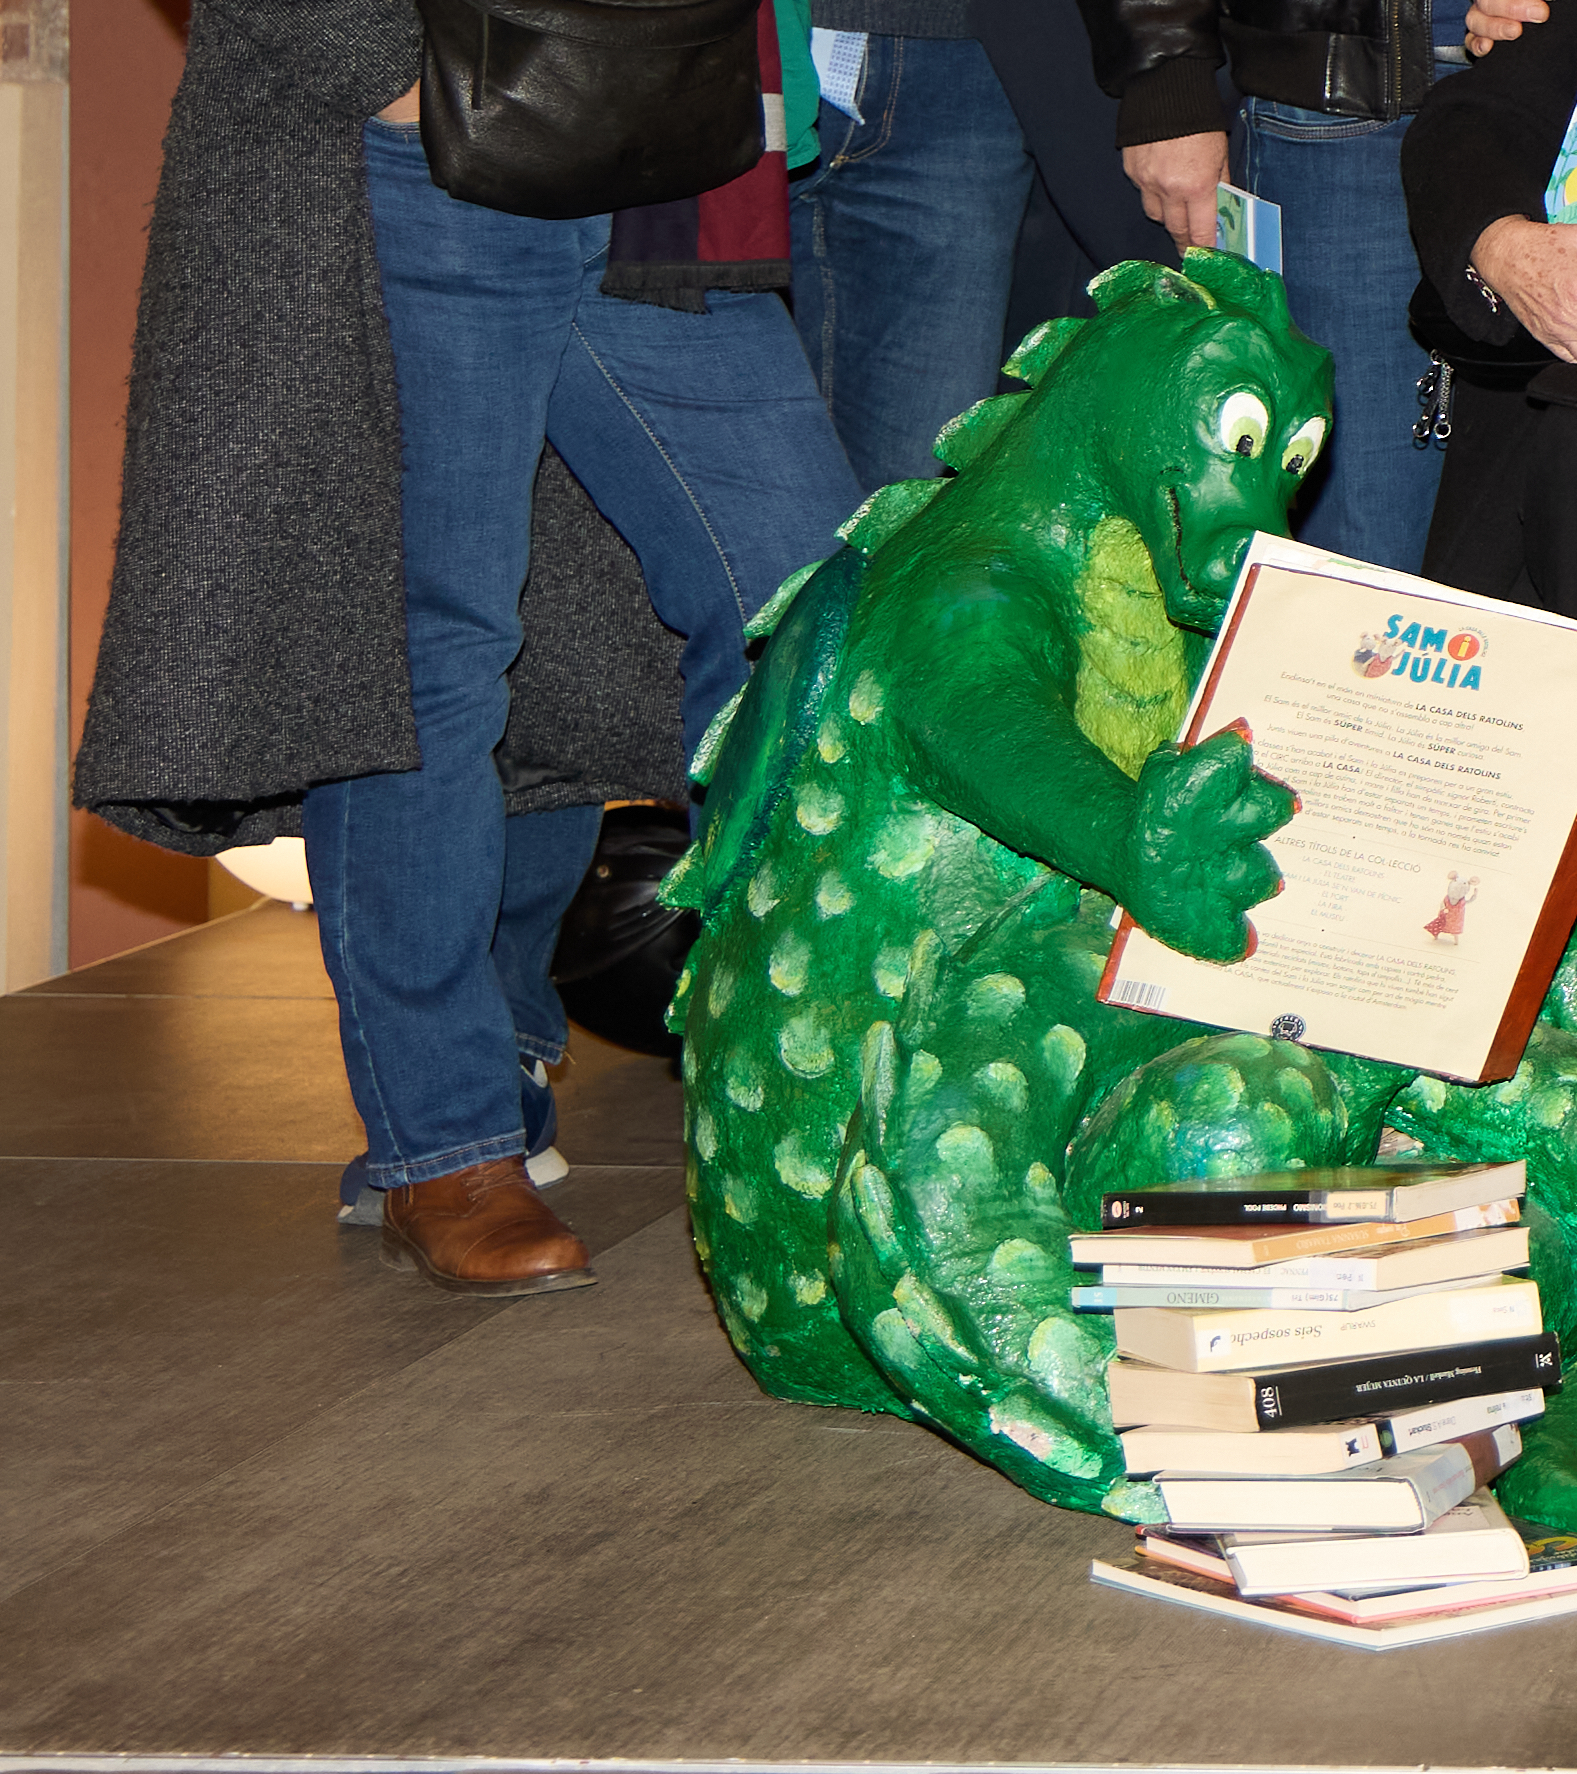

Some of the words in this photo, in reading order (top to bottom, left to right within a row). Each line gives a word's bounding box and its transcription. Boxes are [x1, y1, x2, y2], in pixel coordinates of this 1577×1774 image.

[1383, 614, 1448, 653] SAM
[1391, 651, 1482, 691] JÚLIA
[1414, 702, 1428, 712] LA
[1427, 704, 1454, 717] CASA
[1454, 708, 1478, 722] DELS
[1477, 713, 1525, 731] RATOLINS,
[1391, 749, 1405, 760] LA
[1405, 753, 1432, 767] CASA
[1432, 759, 1456, 772] DELS
[1456, 763, 1502, 781] RATOLINS
[1273, 833, 1307, 849] ALTRES
[1306, 840, 1339, 855] TÍTOLS
[1337, 846, 1353, 859] DE
[1352, 850, 1366, 862] LA
[1365, 852, 1422, 874] COL·LECCIÓ
[1166, 1292, 1220, 1305] GIMENO
[1294, 1324, 1323, 1339] Seis
[1340, 1319, 1376, 1332] SWARUP
[1355, 1379, 1382, 1393] MUJER
[1413, 1374, 1425, 1385] LA
[1260, 1385, 1278, 1419] 408
